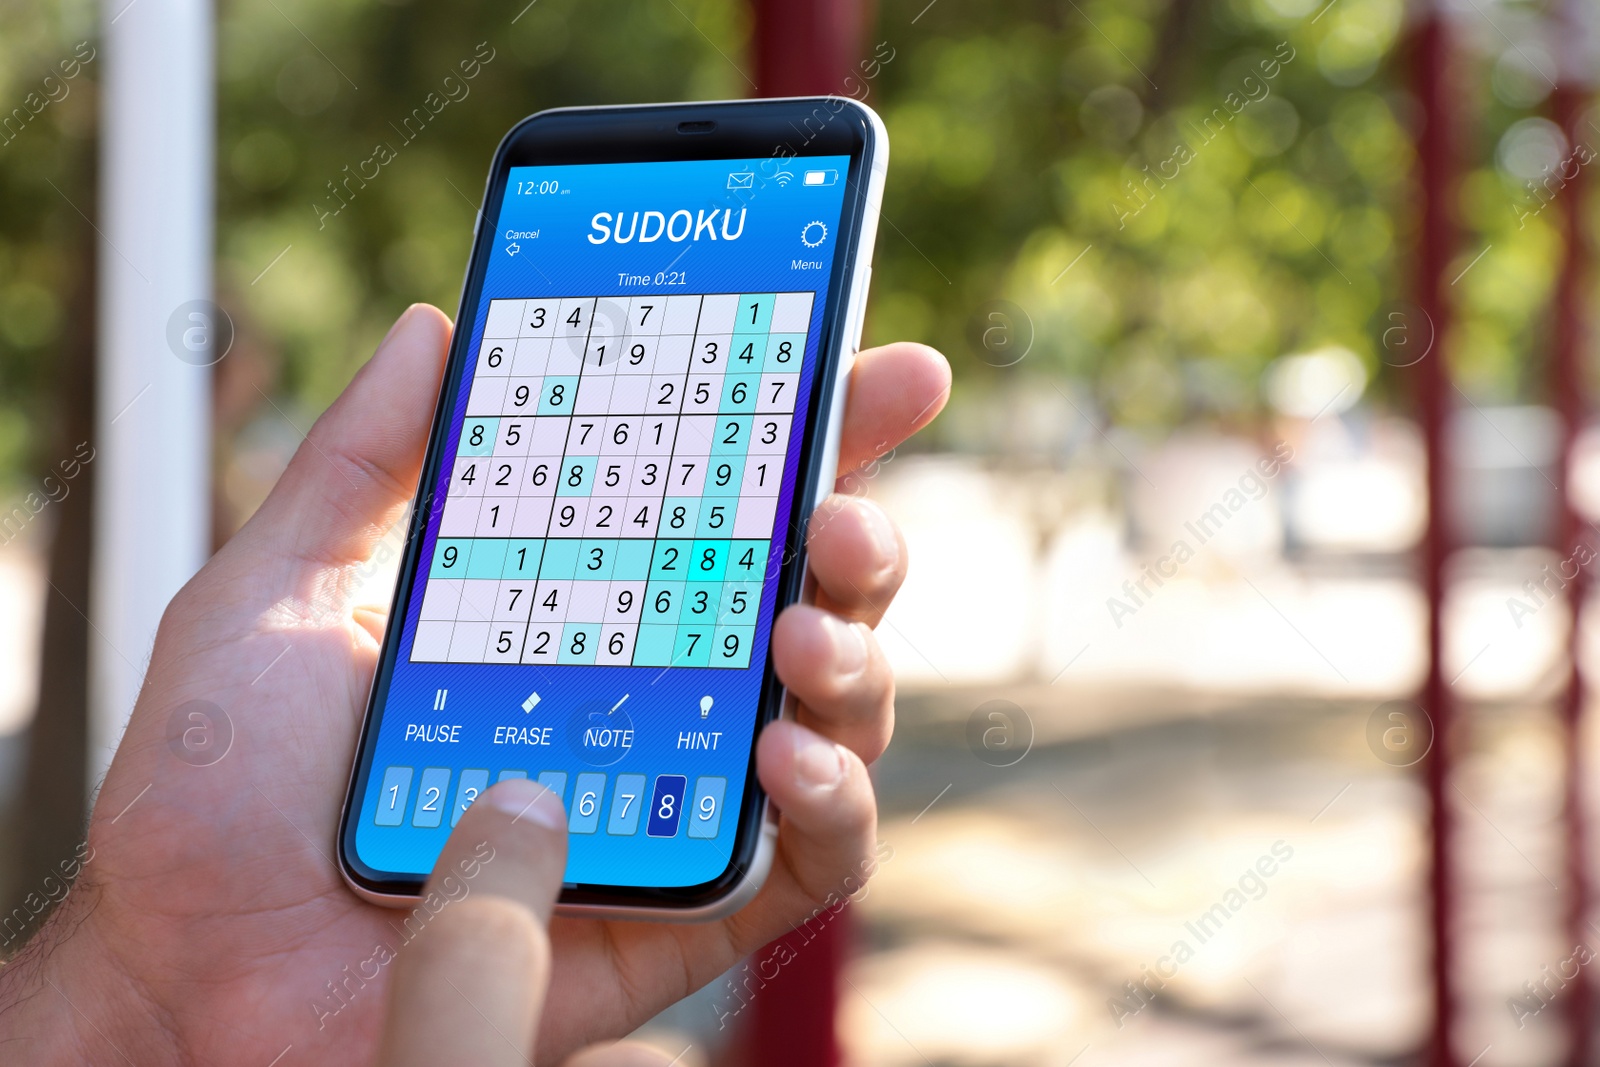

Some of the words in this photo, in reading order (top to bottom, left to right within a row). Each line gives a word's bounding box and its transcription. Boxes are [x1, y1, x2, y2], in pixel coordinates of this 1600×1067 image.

[516, 179, 559, 196] 12:00
[505, 228, 540, 241] Cancel
[587, 207, 747, 245] SUDOKU
[790, 258, 823, 271] Menu
[617, 271, 650, 287] Time
[654, 270, 688, 286] 0:21
[530, 307, 547, 329] 3
[566, 307, 581, 328] 4
[640, 305, 654, 327] 7
[749, 302, 760, 325] 1
[487, 346, 504, 368] 6
[596, 345, 607, 367] 1
[629, 343, 645, 366] 9
[701, 342, 718, 364] 3
[738, 342, 754, 364] 4
[776, 341, 792, 363] 8
[513, 385, 530, 407] 9
[549, 384, 565, 407] 8
[657, 383, 675, 405] 2
[694, 382, 711, 405] 5
[731, 382, 748, 405] 6
[771, 382, 785, 404] 7
[469, 424, 485, 447] 8
[505, 424, 522, 446] 5
[580, 423, 594, 445] 7
[613, 423, 629, 445] 6
[653, 422, 664, 445] 1
[722, 421, 740, 444] 2
[761, 421, 778, 445] 3
[460, 463, 476, 486] 4
[495, 464, 512, 486] 2
[532, 464, 549, 487] 6
[567, 465, 583, 487] 8
[605, 465, 621, 487] 5
[641, 463, 658, 486] 3
[681, 463, 695, 486] 7
[715, 463, 732, 487] 9
[756, 463, 768, 487] 1
[490, 505, 501, 528] 1
[559, 505, 575, 528] 9
[595, 505, 613, 528] 2
[633, 505, 649, 529] 4
[670, 506, 686, 529] 8
[708, 506, 725, 529] 5
[442, 545, 458, 569] 9
[516, 547, 528, 571] 1
[587, 547, 604, 571] 3
[661, 547, 679, 571] 2
[700, 547, 716, 571] 8
[738, 547, 755, 571] 4
[509, 589, 523, 612] 7
[542, 589, 558, 612] 4
[616, 590, 633, 614] 9
[655, 590, 672, 614] 6
[691, 590, 709, 615] 3
[730, 591, 748, 615] 5
[496, 630, 513, 654] 5
[533, 631, 551, 655] 2
[570, 631, 587, 655] 8
[608, 631, 625, 656] 6
[687, 633, 702, 657] 7
[722, 634, 739, 658] 9
[404, 723, 462, 743] PAUSE
[493, 726, 553, 746] ERASE
[583, 728, 634, 748] NOTE
[677, 730, 723, 751] HINT
[389, 784, 400, 810] 1
[422, 787, 440, 811] 2
[579, 791, 597, 817] 6
[621, 794, 636, 818] 7
[658, 794, 675, 819] 8
[698, 796, 716, 821] 9
